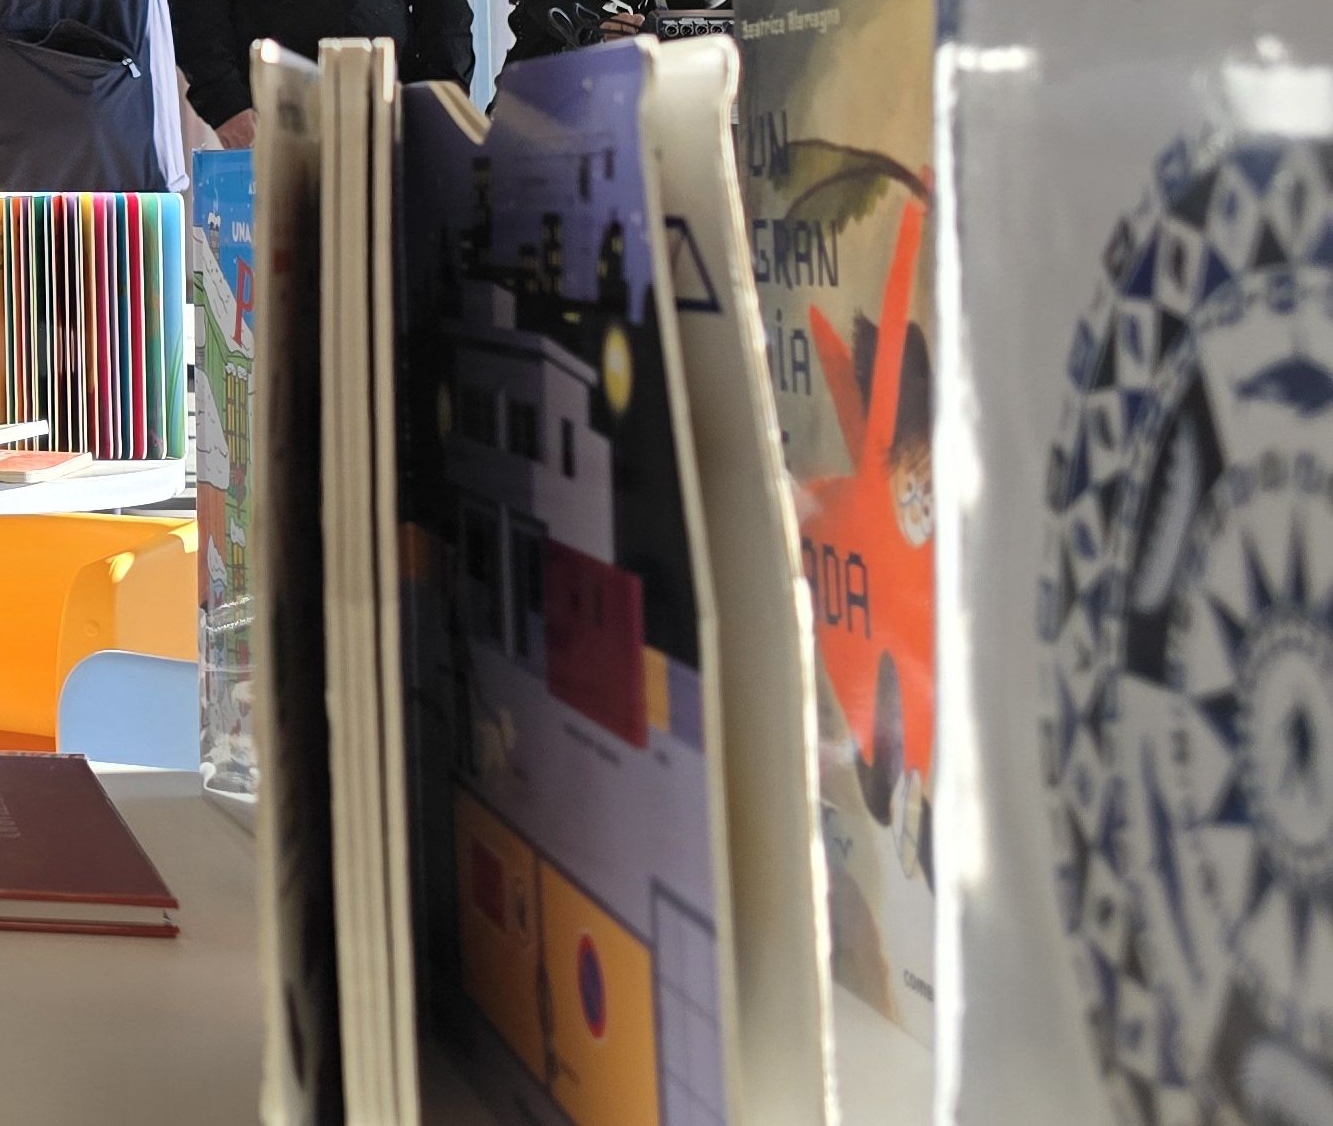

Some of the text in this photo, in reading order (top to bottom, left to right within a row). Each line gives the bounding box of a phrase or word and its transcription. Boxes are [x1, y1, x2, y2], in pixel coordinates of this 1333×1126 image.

[748, 110, 790, 178] UN
[231, 221, 252, 243] UNA
[752, 218, 839, 291] GRAN
[767, 306, 812, 397] ÍA
